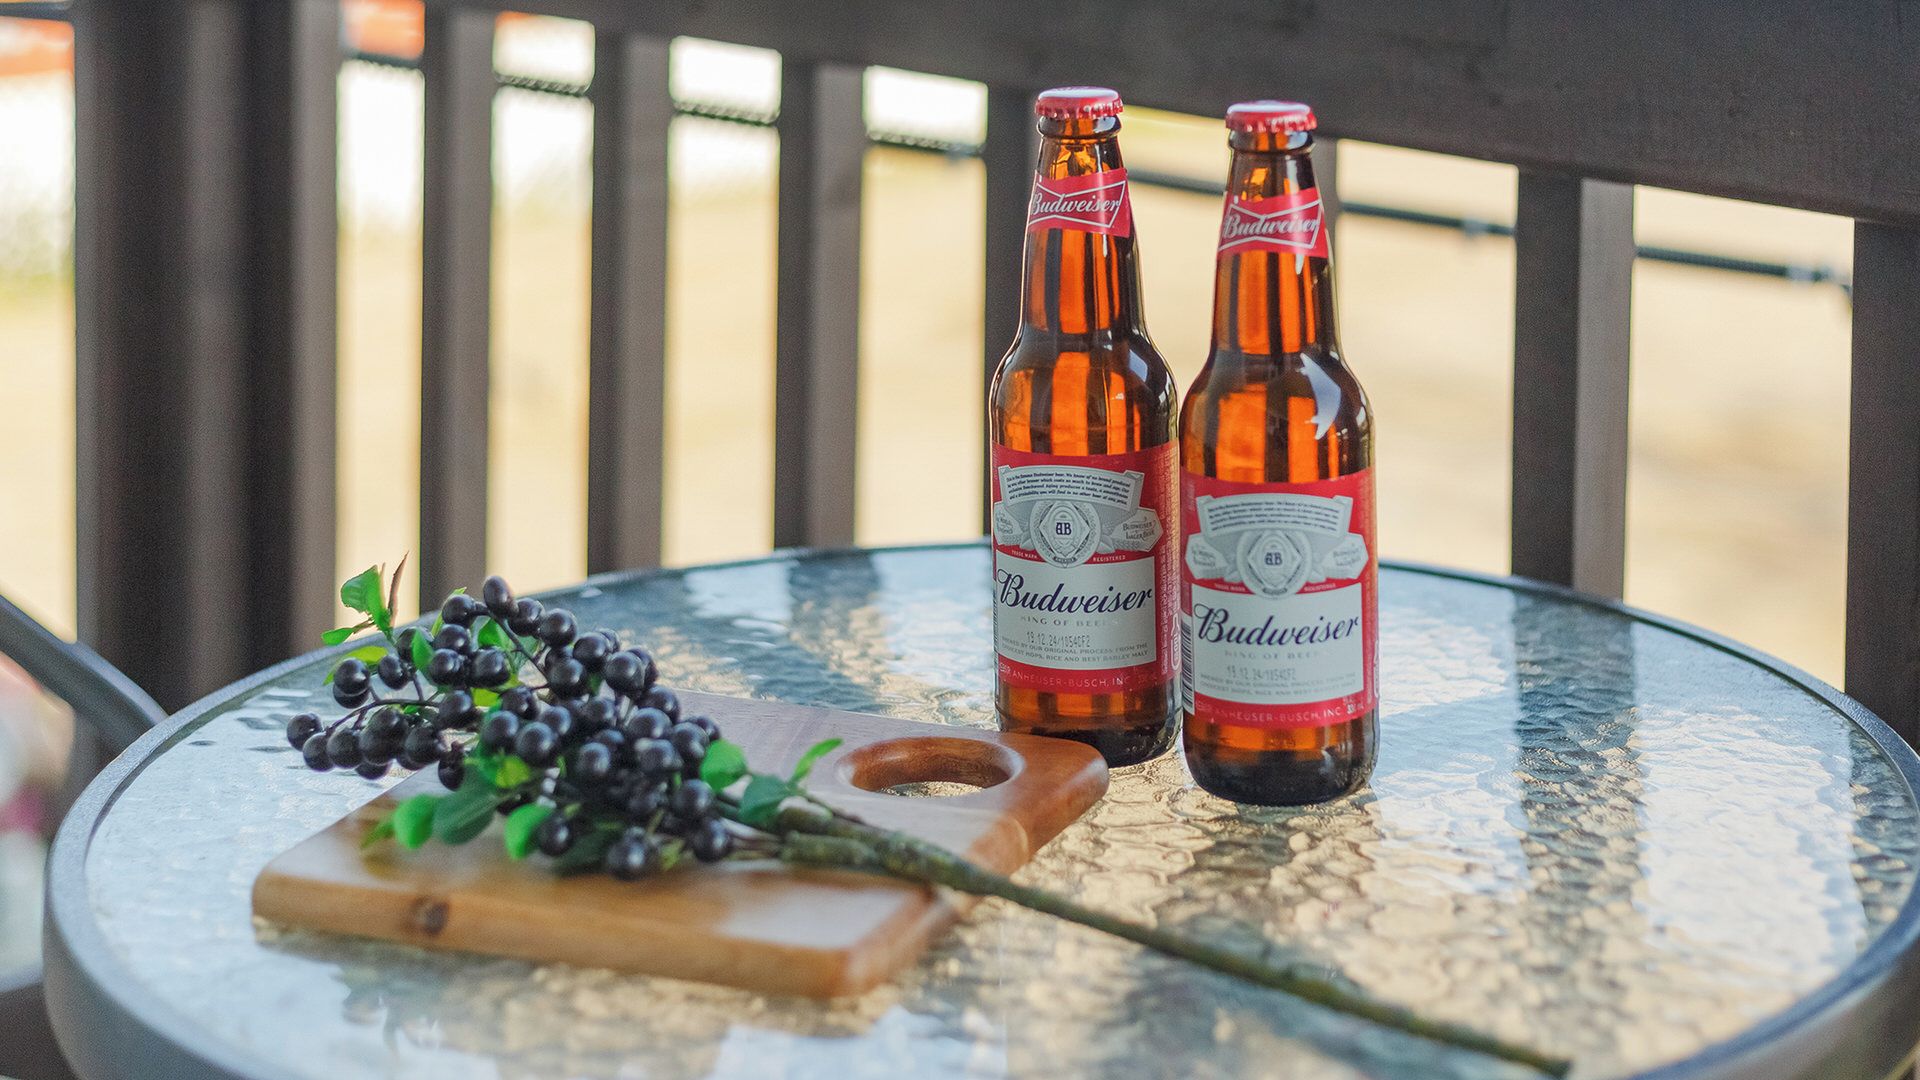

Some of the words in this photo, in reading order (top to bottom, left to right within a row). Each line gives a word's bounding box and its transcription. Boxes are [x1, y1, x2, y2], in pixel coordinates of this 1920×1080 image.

[1030, 191, 1121, 216] Budweiser
[1223, 213, 1319, 239] Budweiser
[1092, 554, 1126, 563] REGISTERED
[997, 569, 1152, 613] Budweiser
[1194, 603, 1359, 645] Budweiser
[1044, 646, 1077, 655] ORIGINAL
[1115, 645, 1135, 653] FROM
[1046, 653, 1063, 661] RICE
[1131, 649, 1149, 658] MALT
[1323, 706, 1341, 718] INC
